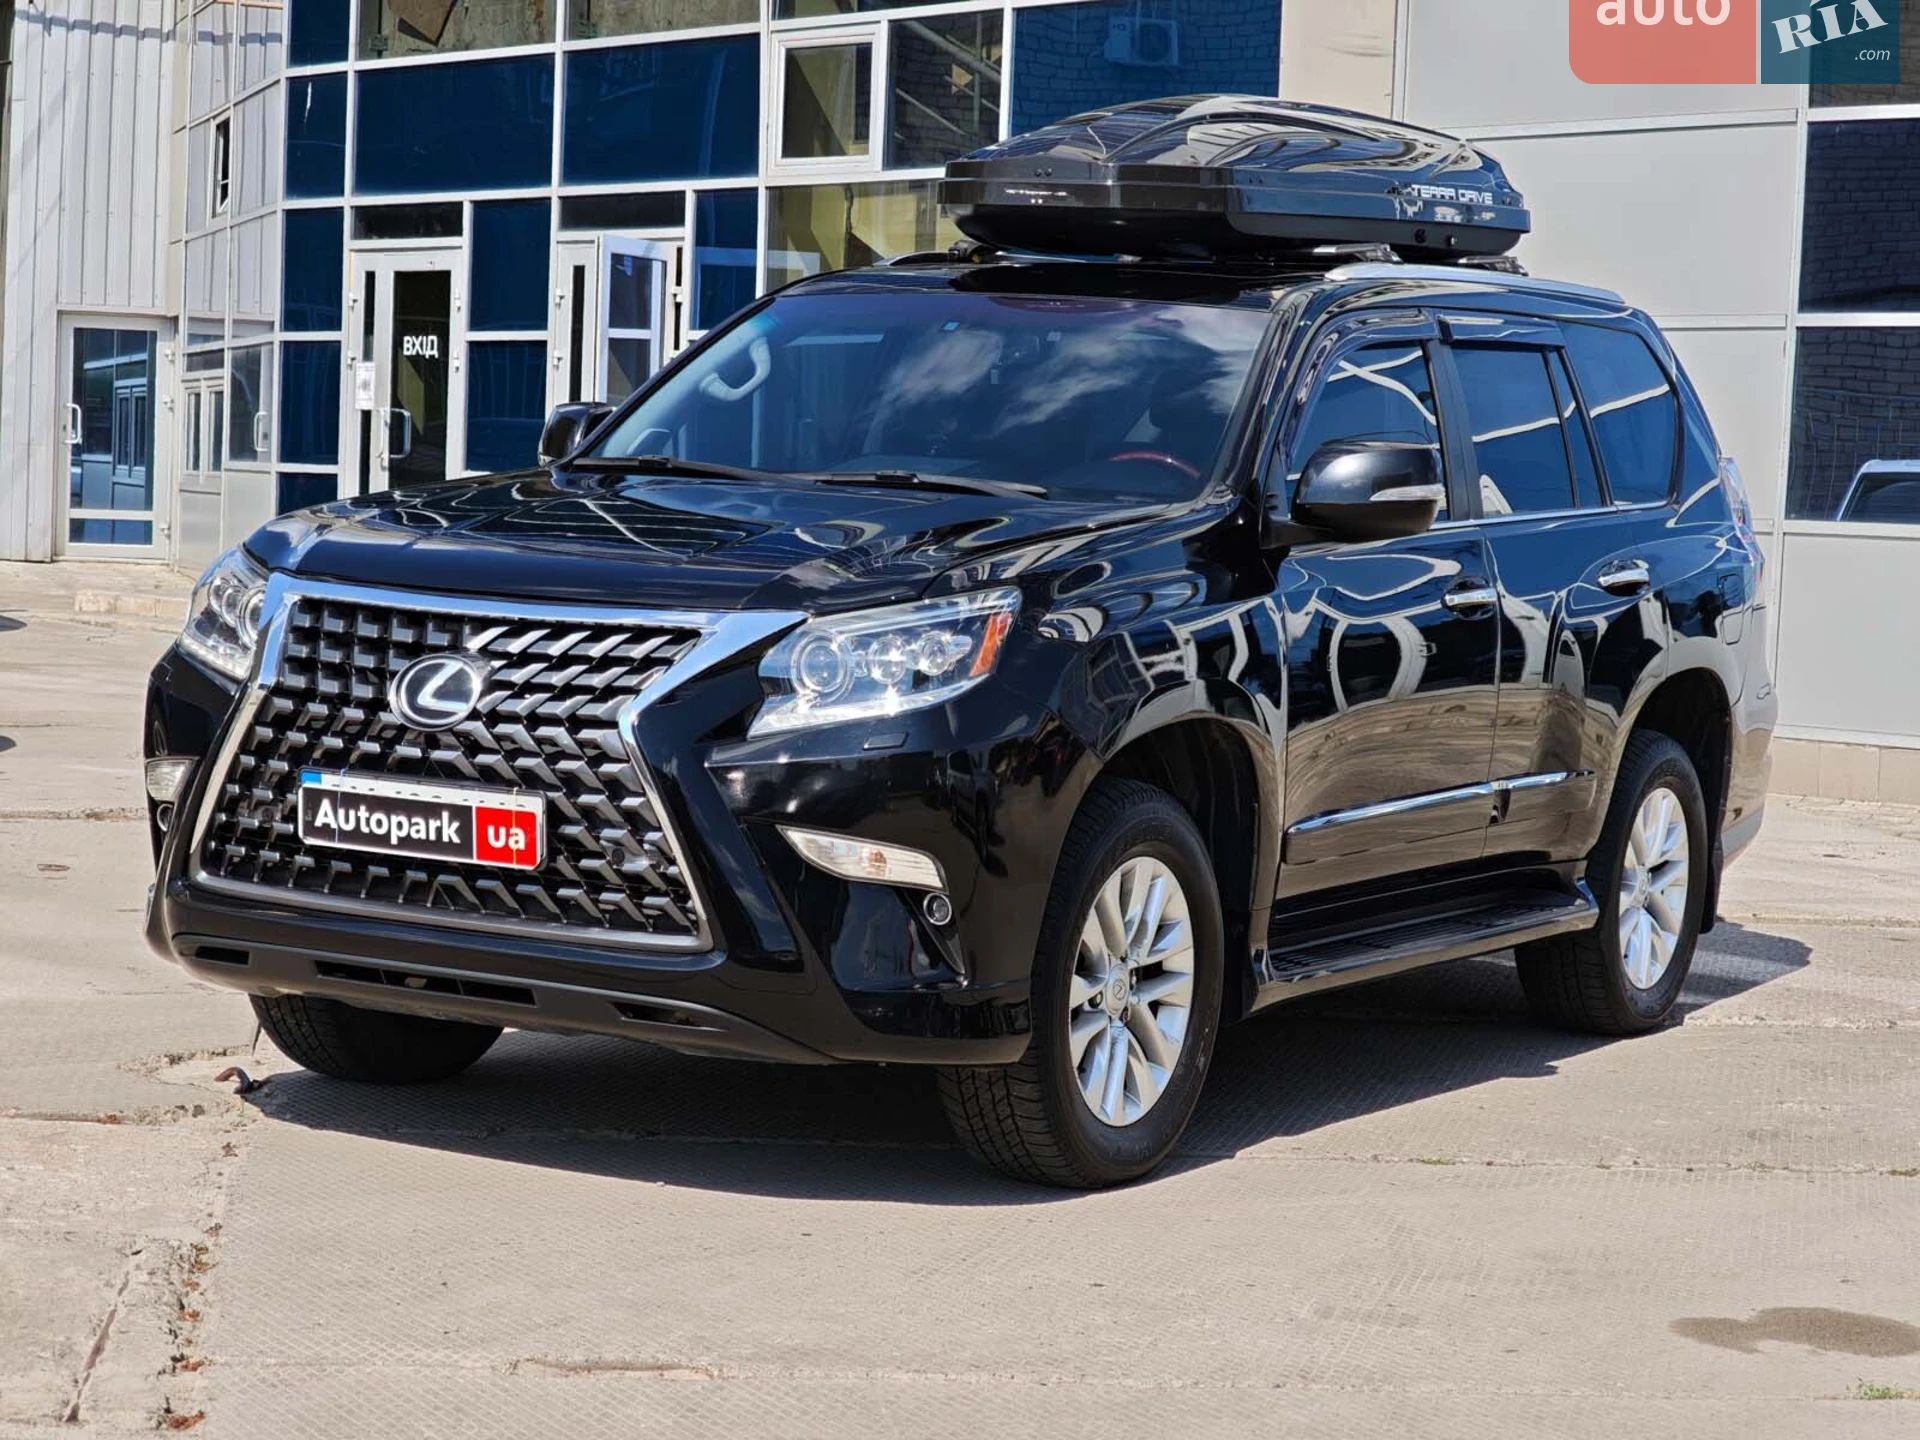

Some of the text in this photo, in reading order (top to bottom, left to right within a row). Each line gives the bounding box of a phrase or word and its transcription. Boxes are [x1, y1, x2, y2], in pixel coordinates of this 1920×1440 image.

[1411, 184, 1455, 200] TERRA
[403, 335, 438, 358] ВХІД
[314, 798, 460, 845] Autopark
[487, 824, 526, 851] ua
